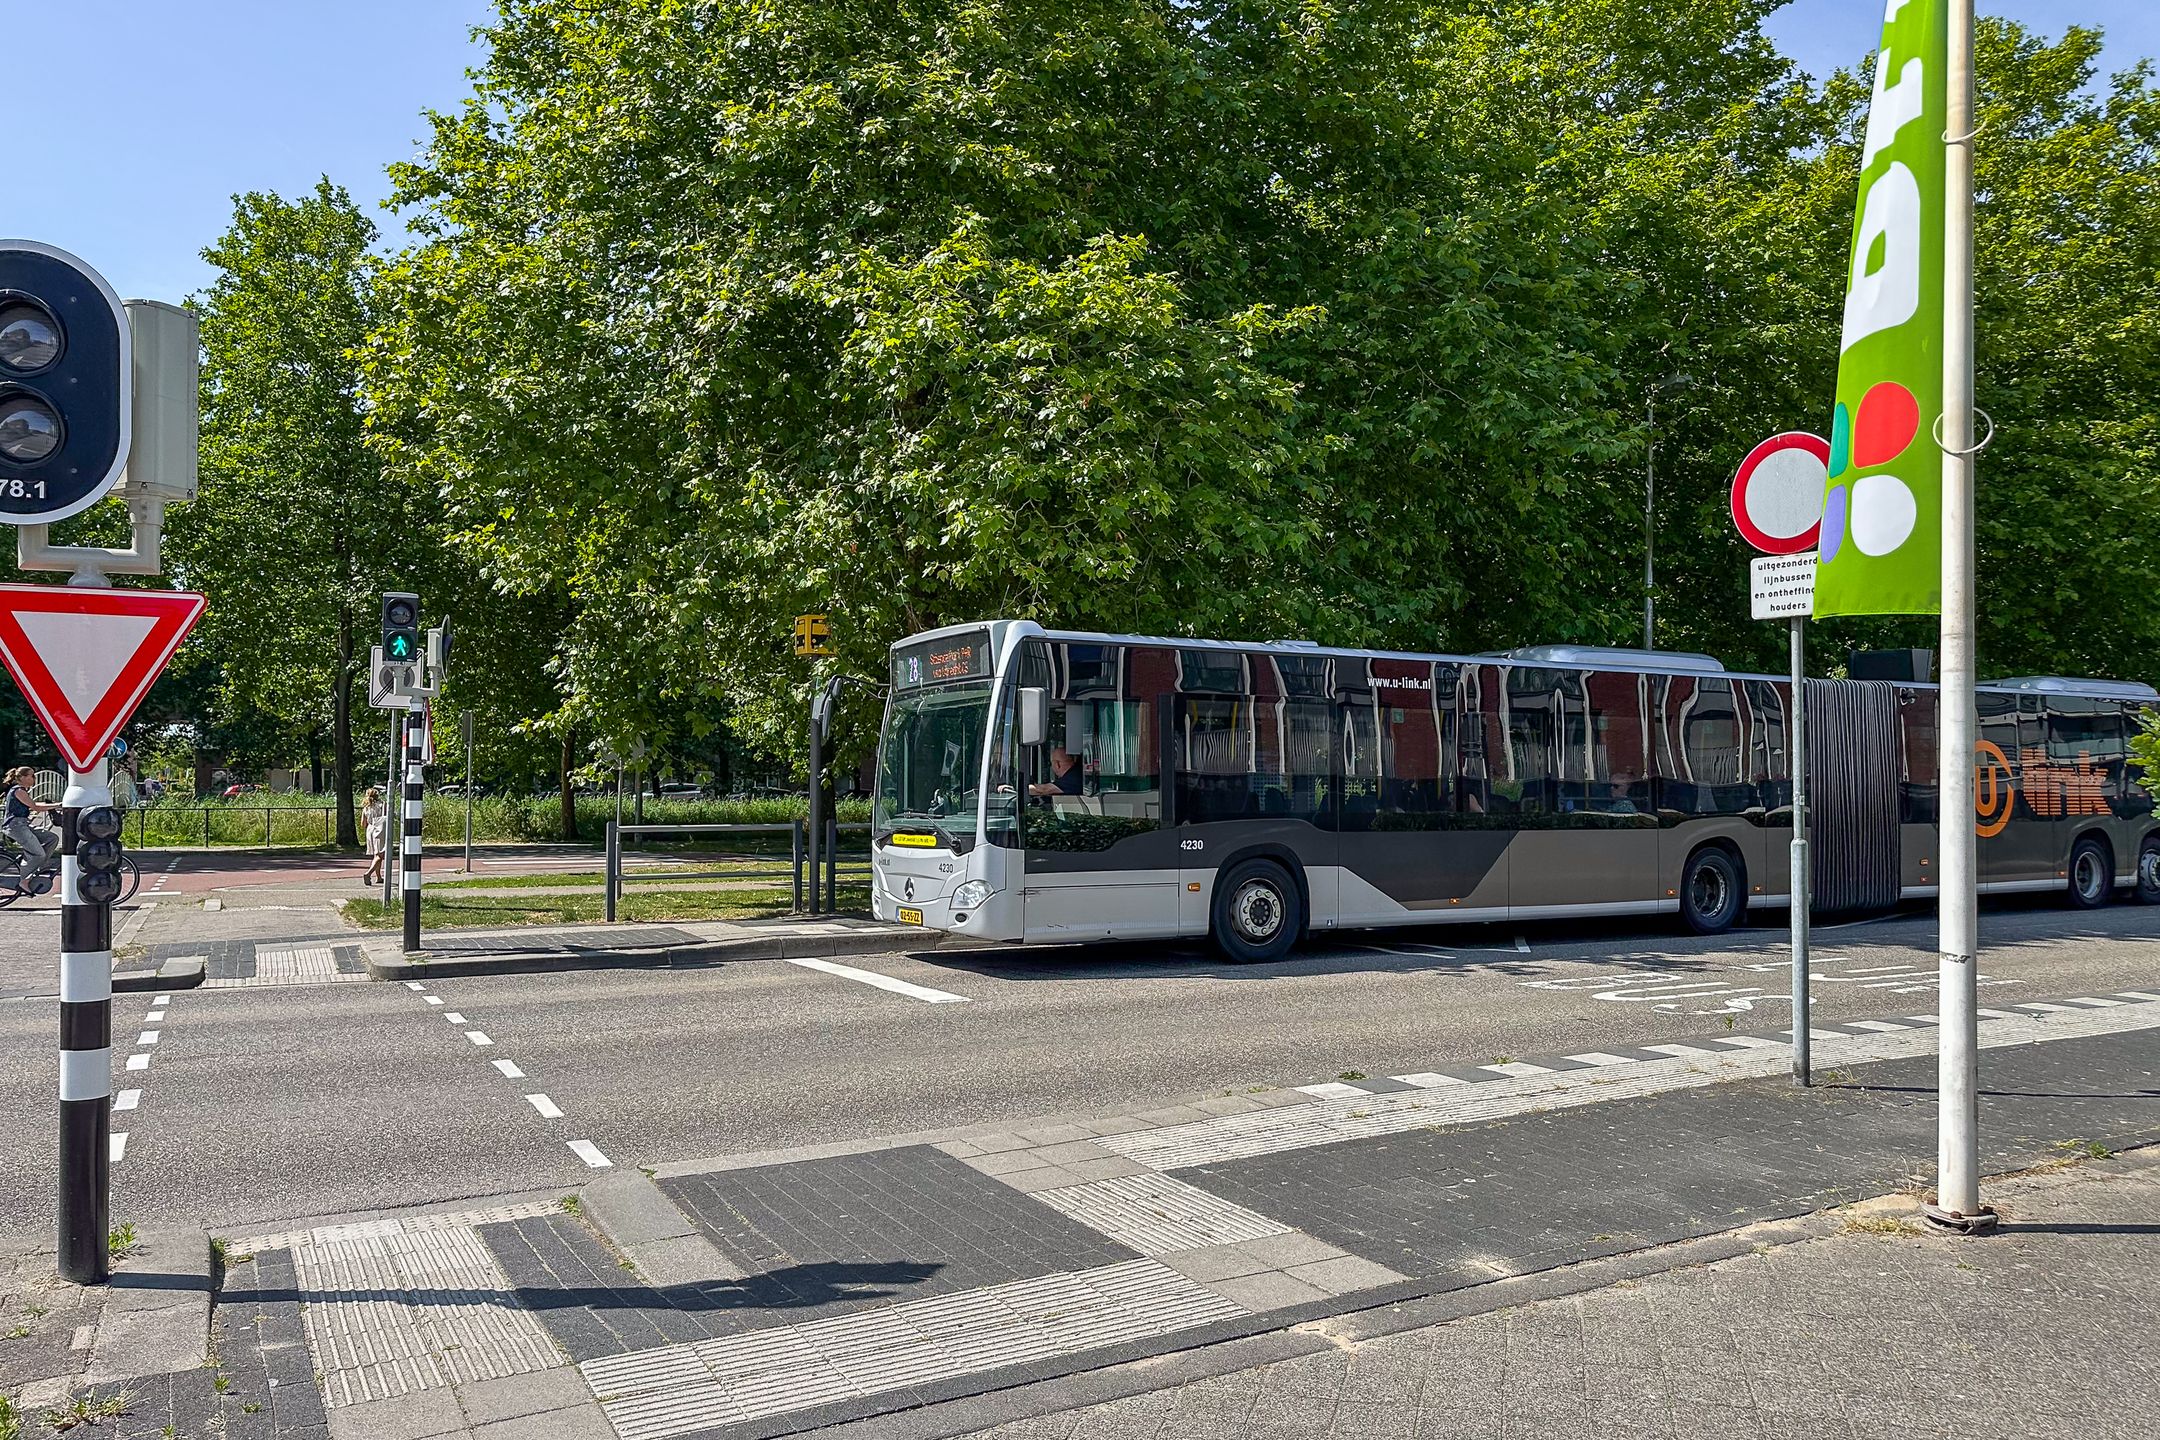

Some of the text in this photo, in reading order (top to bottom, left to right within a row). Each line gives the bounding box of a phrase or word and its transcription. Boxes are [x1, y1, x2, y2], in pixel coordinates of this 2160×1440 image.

[0, 479, 45, 499] 78.1
[1757, 556, 1818, 572] uitgezonderd
[1763, 573, 1812, 586] lijnbussen
[1770, 602, 1807, 612] houders
[1367, 676, 1431, 690] www.u-link.nl
[1180, 839, 1204, 850] 4230
[938, 862, 954, 873] 4230
[1514, 972, 1818, 1015] BUS
